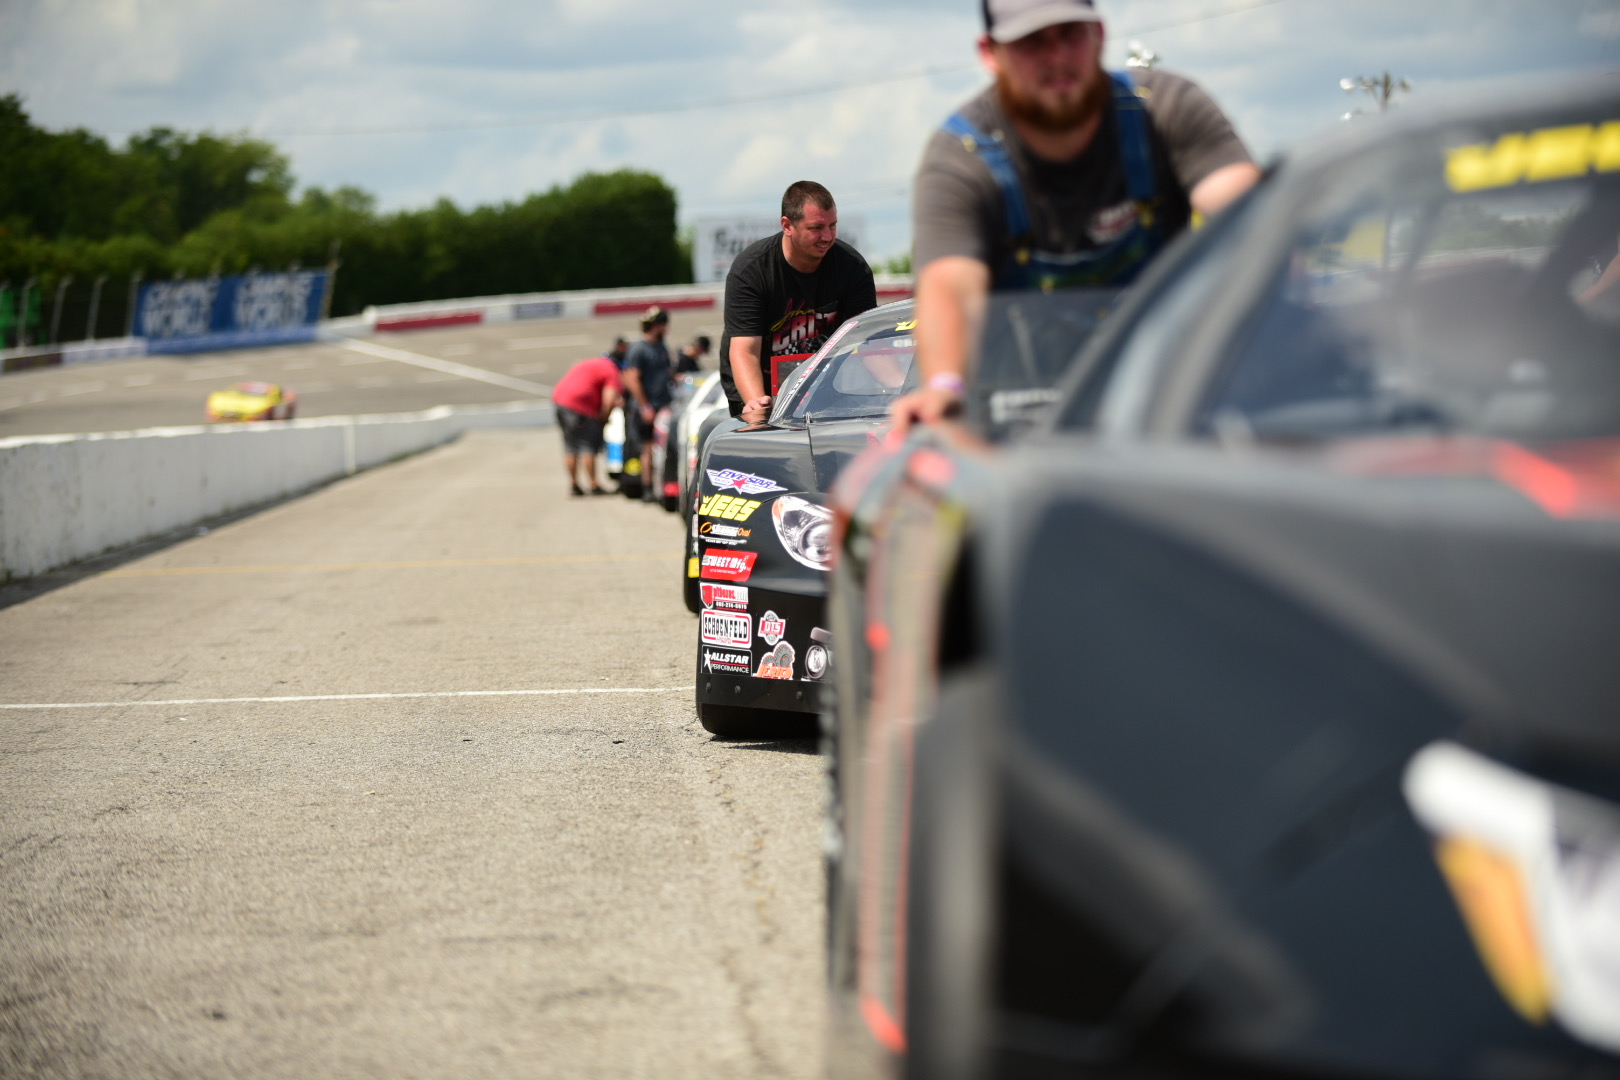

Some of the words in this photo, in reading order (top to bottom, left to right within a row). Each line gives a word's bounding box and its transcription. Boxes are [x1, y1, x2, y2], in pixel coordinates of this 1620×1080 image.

[718, 470, 746, 481] FIVE
[747, 476, 774, 489] STAR
[699, 493, 762, 522] JEGS
[705, 555, 731, 568] SWEET
[704, 616, 748, 639] SCHOENFELD
[711, 652, 749, 664] ALLSTAR
[711, 664, 749, 674] PERFORMANCE
